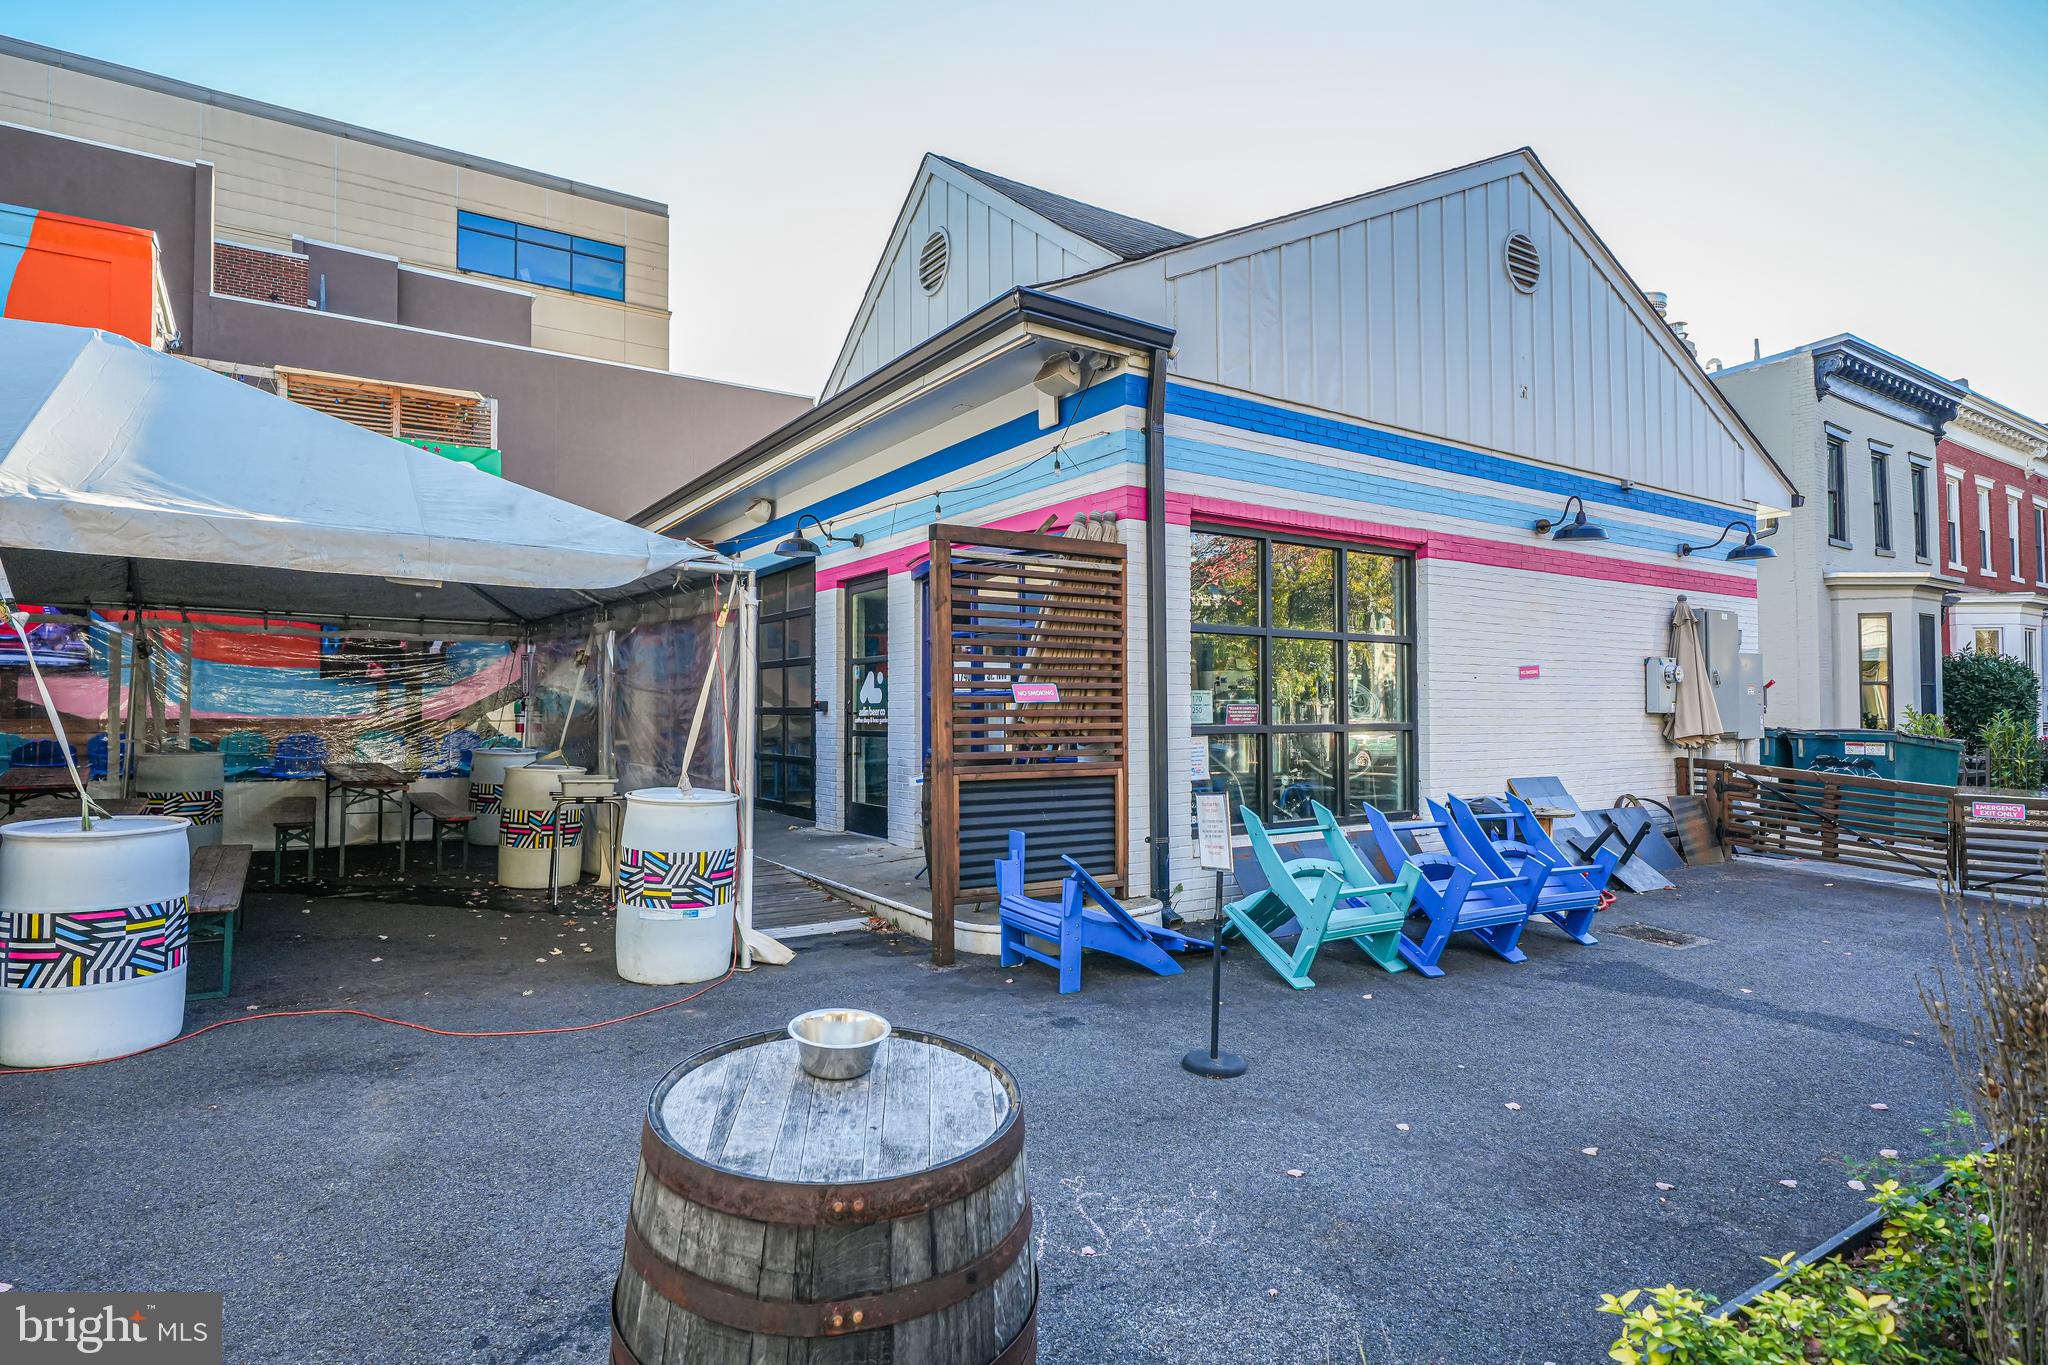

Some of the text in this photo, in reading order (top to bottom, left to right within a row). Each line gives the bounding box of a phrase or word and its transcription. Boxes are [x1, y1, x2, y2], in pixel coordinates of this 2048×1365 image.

[1192, 695, 1202, 703] 170
[869, 706, 880, 716] beer
[880, 708, 886, 716] co
[1192, 706, 1202, 714] 250
[1975, 804, 2022, 812] EMERGENCY
